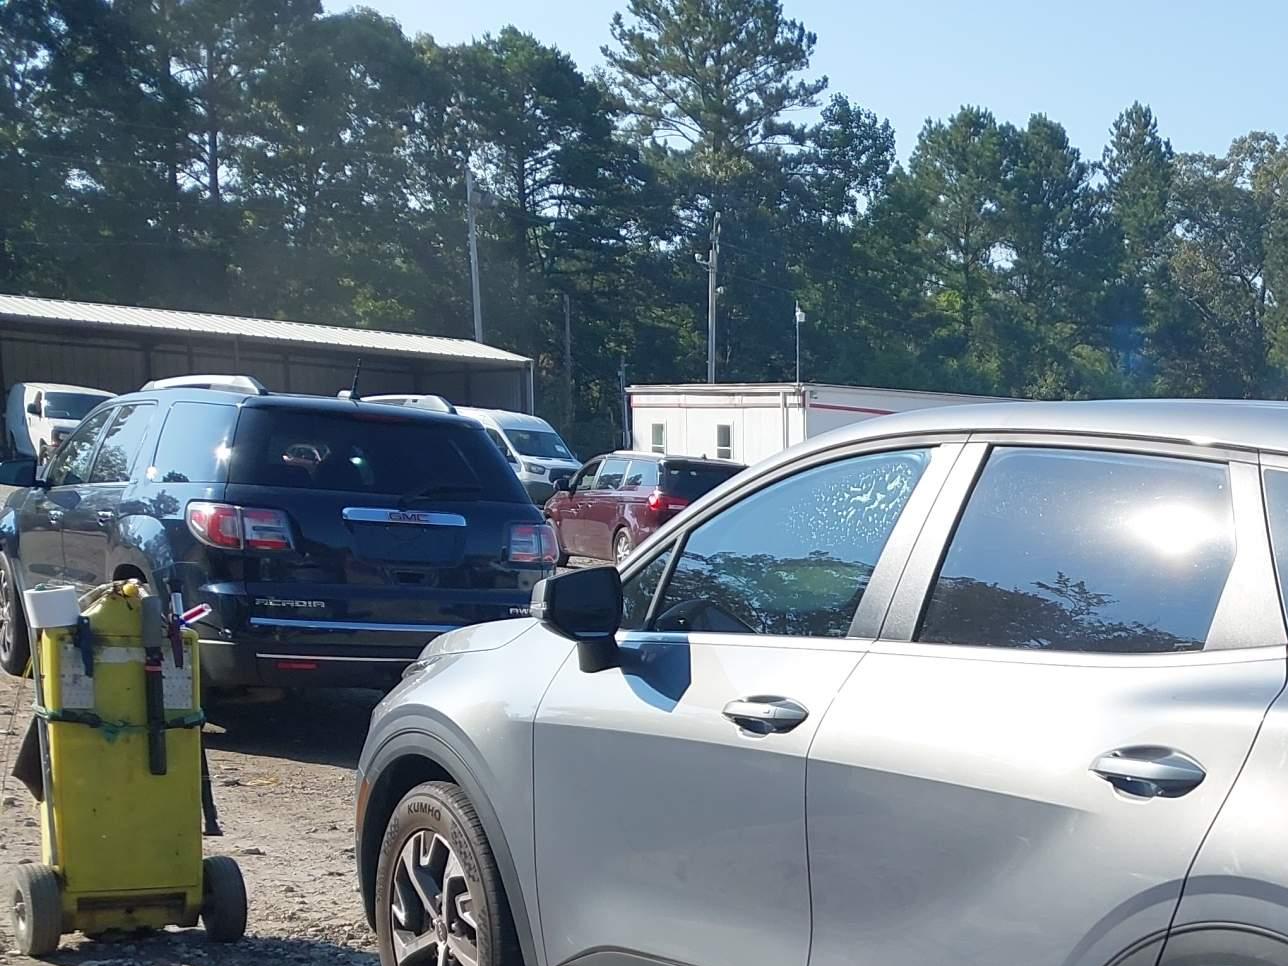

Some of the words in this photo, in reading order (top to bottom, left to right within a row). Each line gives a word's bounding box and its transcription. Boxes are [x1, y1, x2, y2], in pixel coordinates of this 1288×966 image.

[388, 511, 430, 522] GMC
[255, 598, 326, 608] ACADIA
[510, 607, 529, 615] AW
[407, 801, 442, 821] KUMHO
